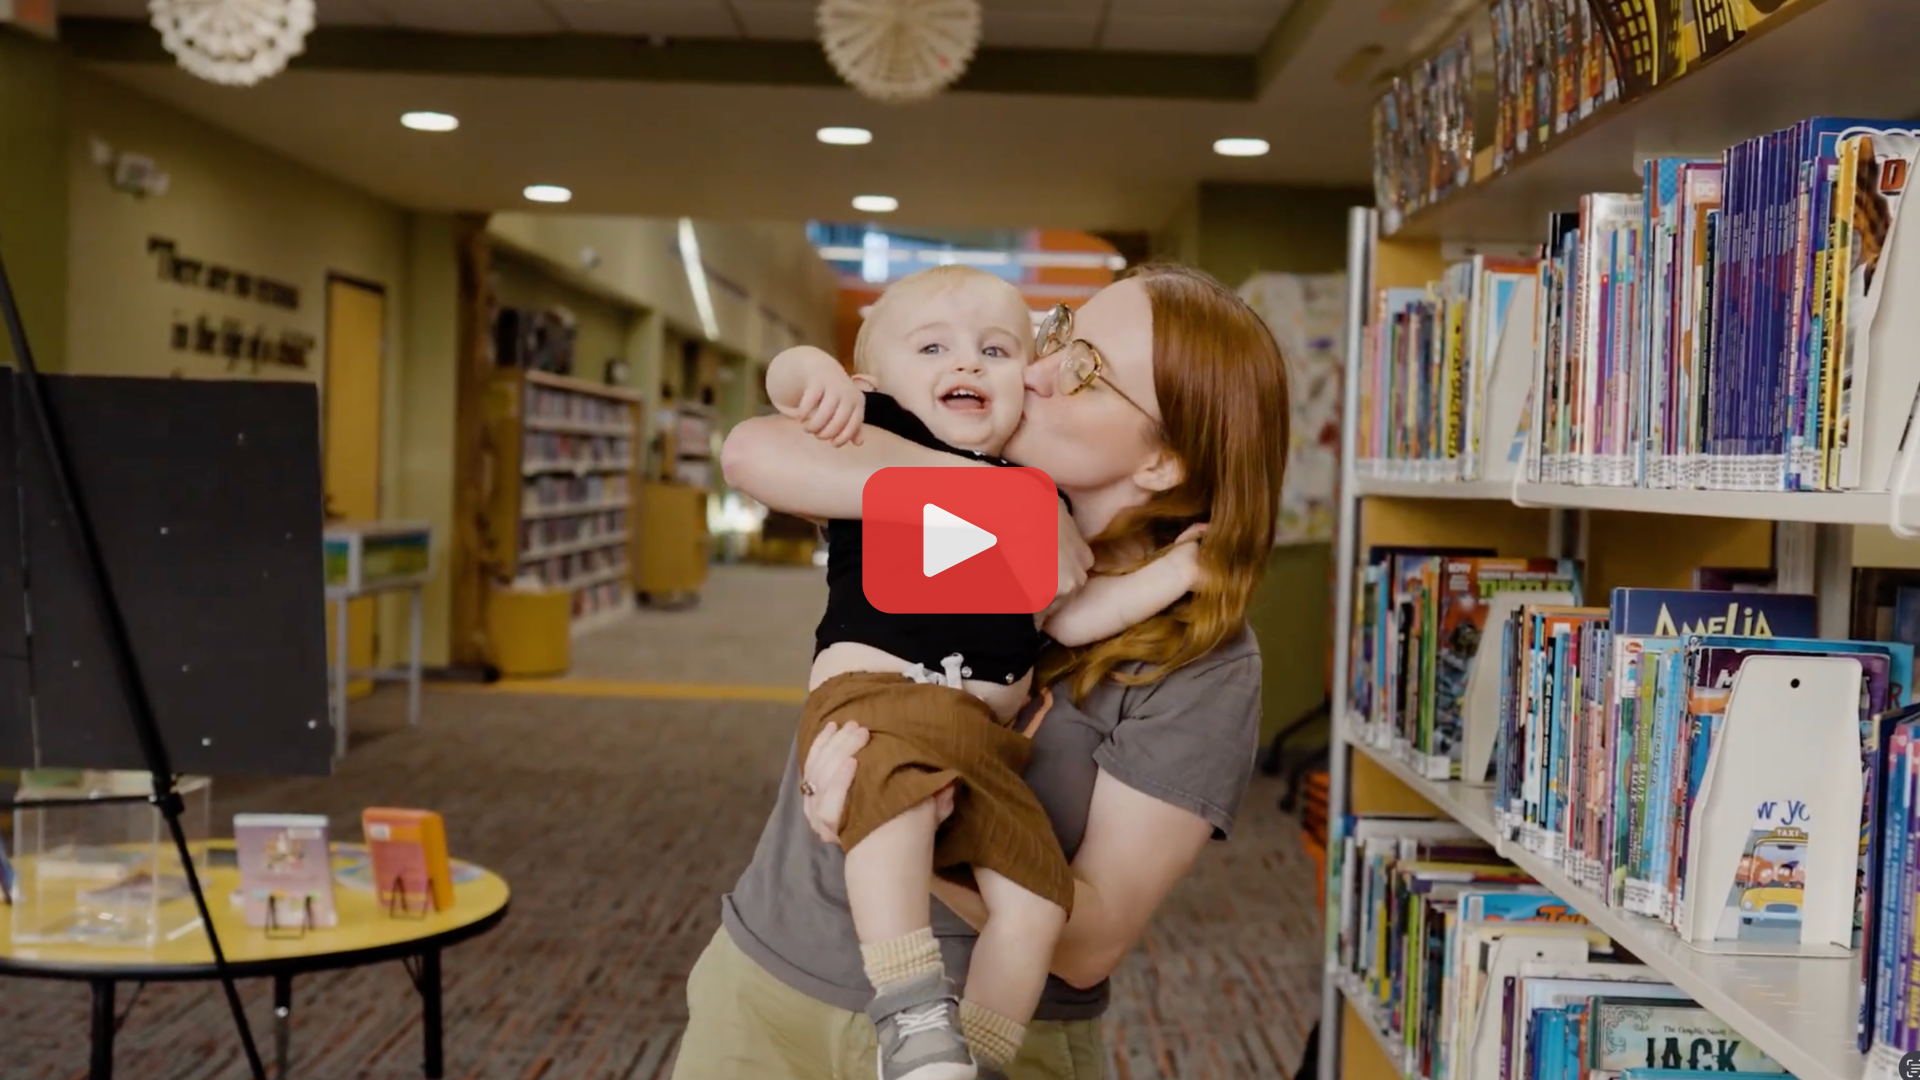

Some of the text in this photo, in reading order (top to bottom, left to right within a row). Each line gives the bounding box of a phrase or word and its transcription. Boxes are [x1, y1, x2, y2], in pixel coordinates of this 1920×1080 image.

[1757, 802, 1777, 819] w
[1776, 829, 1800, 837] TAXI
[1646, 1037, 1741, 1072] JACK
